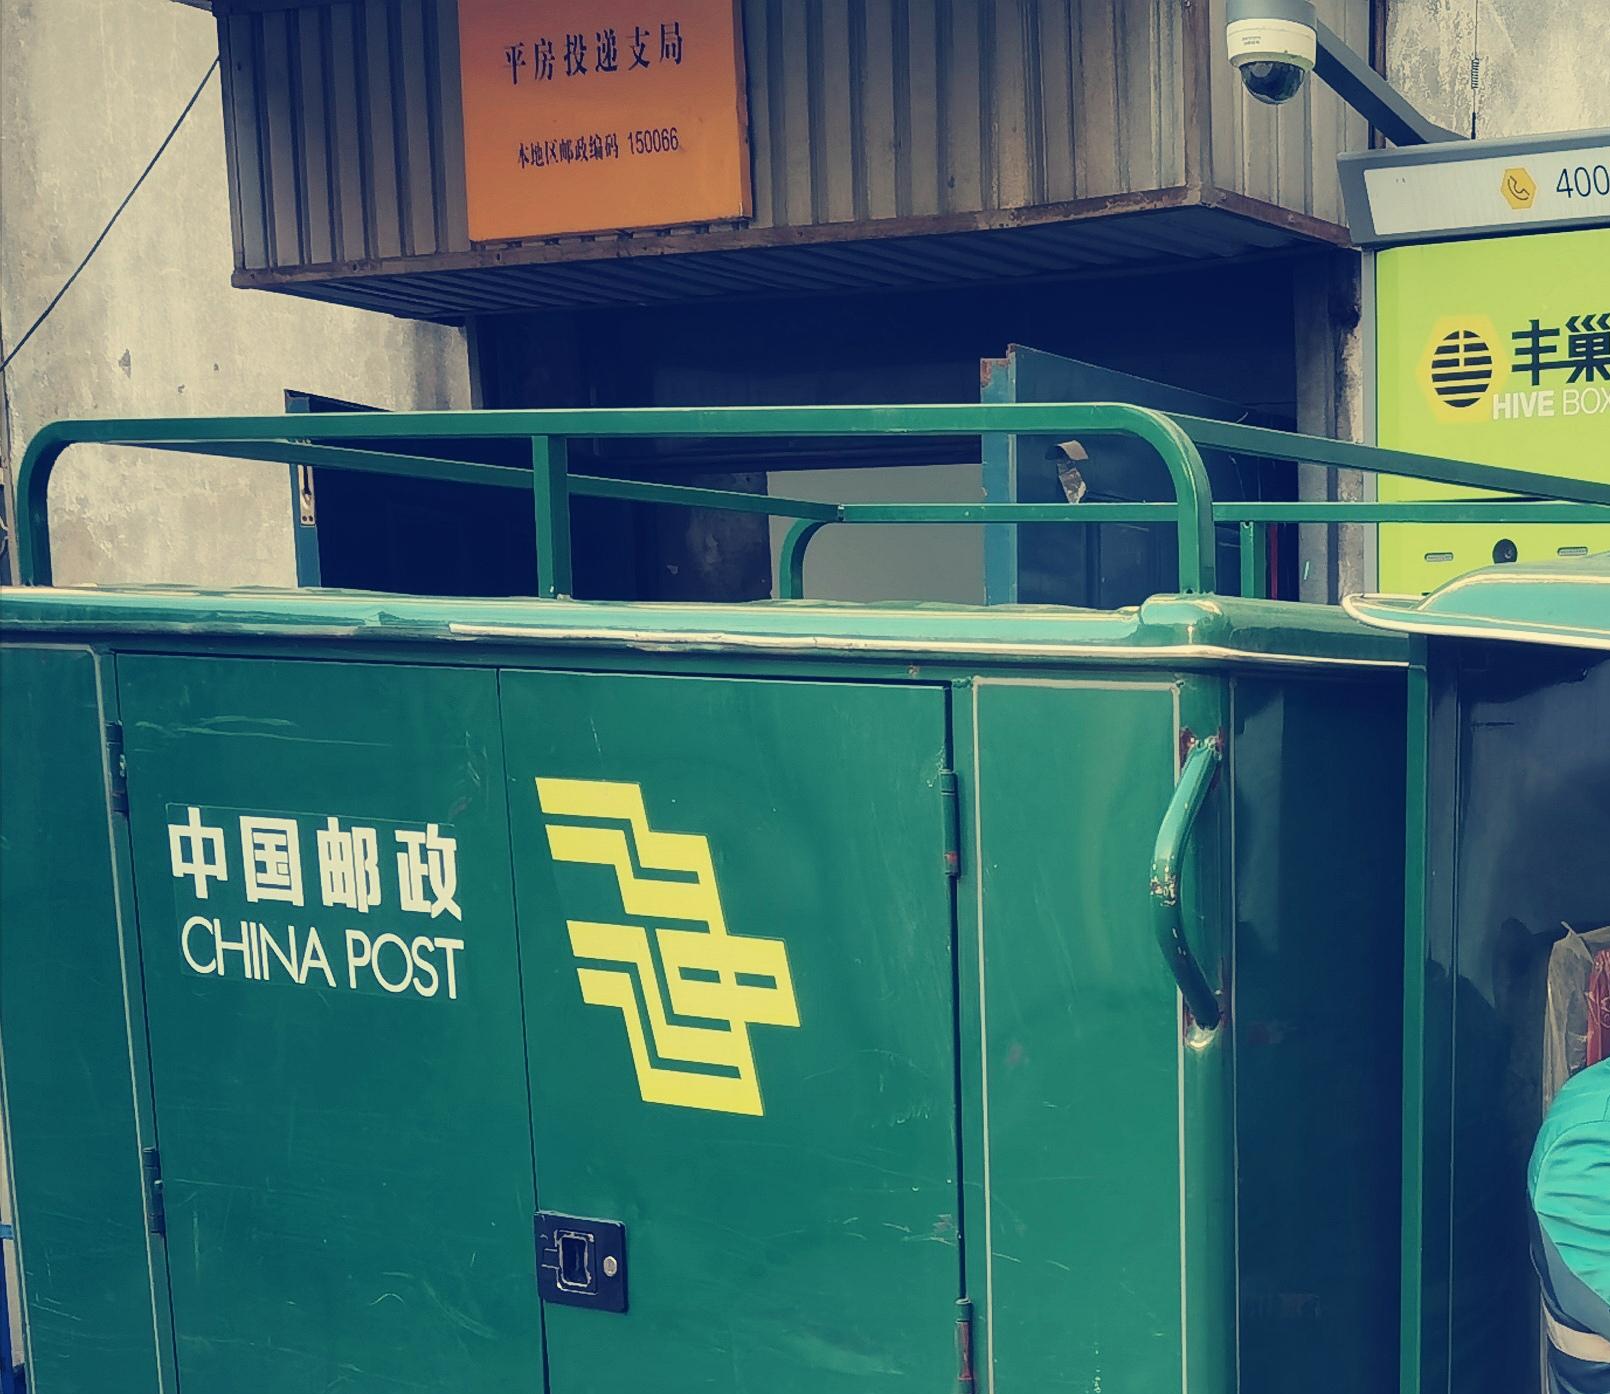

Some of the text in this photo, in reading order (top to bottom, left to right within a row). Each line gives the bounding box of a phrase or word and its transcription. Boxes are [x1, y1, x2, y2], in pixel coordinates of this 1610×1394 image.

[505, 21, 683, 85] 平房投递支局
[518, 127, 679, 168] 本地区邮政编码 150066
[1493, 389, 1555, 420] HIVE
[167, 806, 462, 921] 中国邮政
[181, 915, 465, 999] CHINA POST
